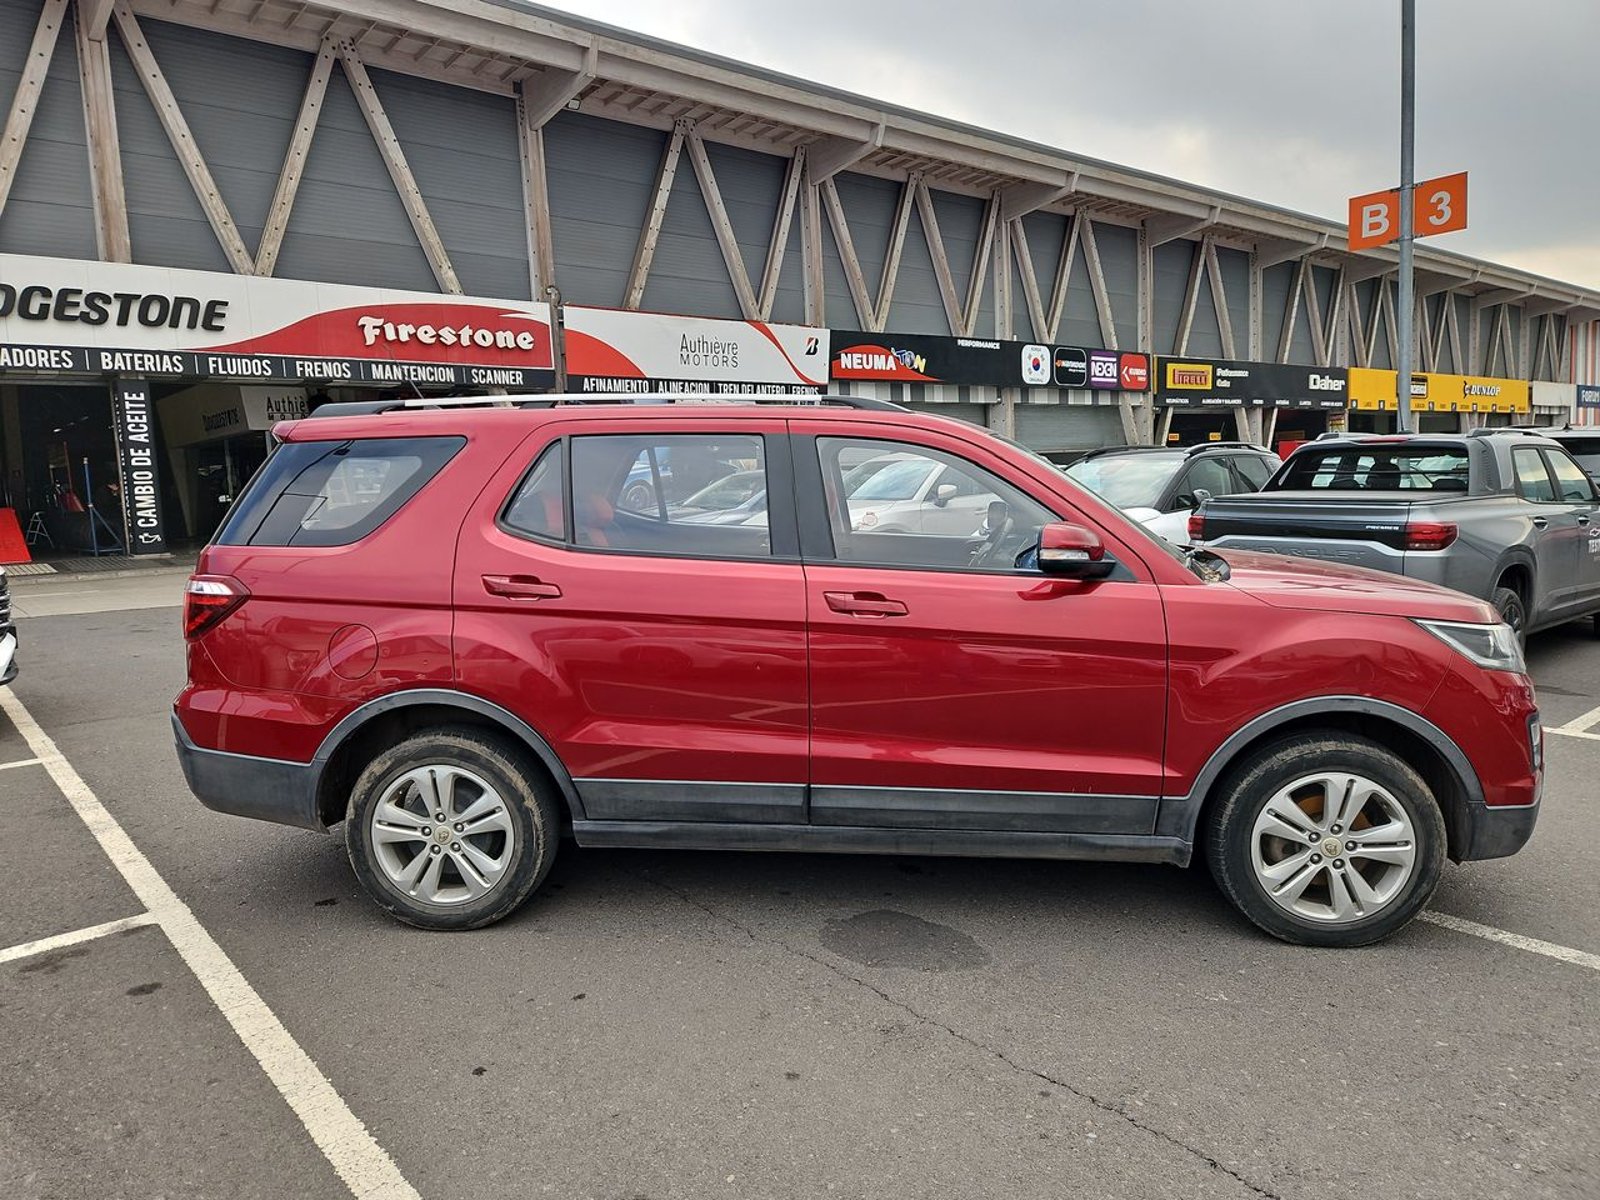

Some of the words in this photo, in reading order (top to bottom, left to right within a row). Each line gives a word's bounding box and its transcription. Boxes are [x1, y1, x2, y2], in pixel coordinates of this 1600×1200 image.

[1362, 203, 1390, 239] B
[1428, 190, 1452, 226] 3
[358, 315, 535, 351] Firestone
[680, 333, 738, 356] Authièvre
[0, 347, 74, 369] ADORES
[101, 352, 184, 373] BATERIAS
[208, 357, 272, 377] FLUIDOS
[295, 360, 351, 379] FRENOS
[371, 363, 455, 382] MANTENCION
[471, 368, 524, 385] SCANNER
[680, 353, 739, 368] MOTORS
[583, 377, 649, 393] AFINAMIENTO
[658, 380, 710, 394] ALINEACION
[1173, 368, 1208, 386] PIRELLI
[1309, 374, 1346, 391] Daher
[124, 392, 149, 443] ACEITE
[130, 448, 152, 466] DE
[132, 471, 158, 528] CAMBIO
